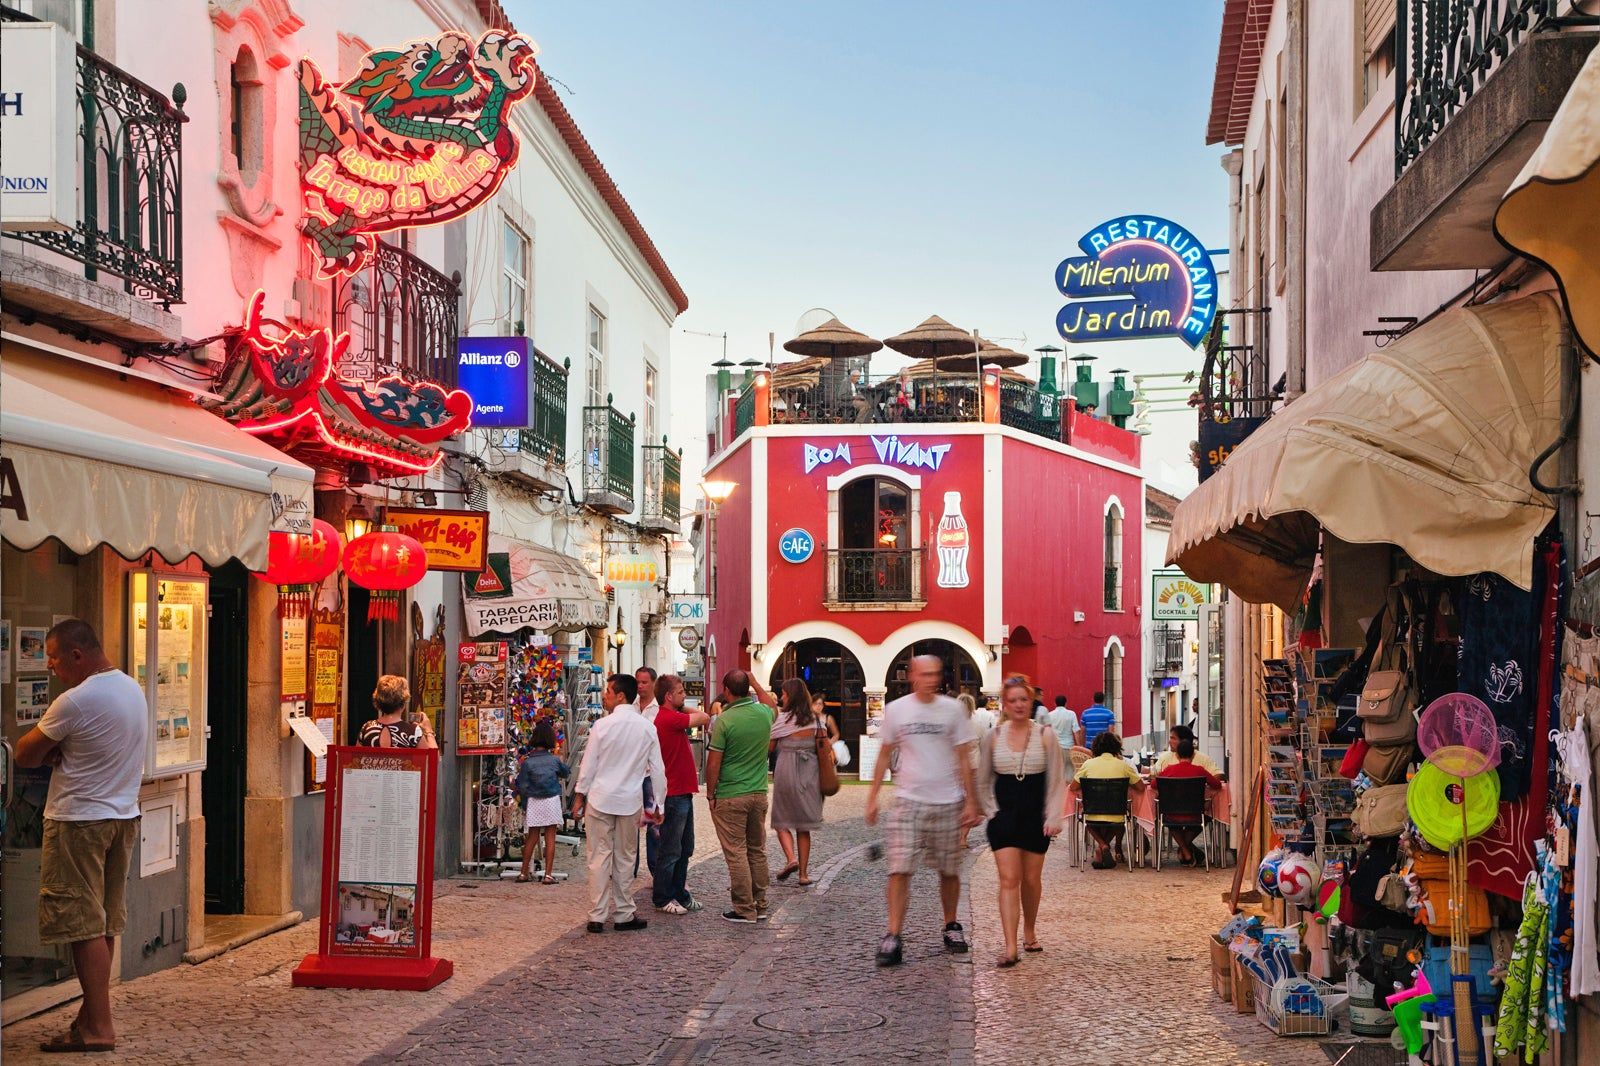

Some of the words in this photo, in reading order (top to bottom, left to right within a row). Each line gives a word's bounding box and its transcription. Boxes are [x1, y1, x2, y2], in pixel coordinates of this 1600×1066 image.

[340, 143, 462, 184] RESTAURANTE
[394, 186, 422, 208] da
[1063, 258, 1170, 288] Milenium
[1090, 219, 1213, 335] RESTAURANTE
[1063, 303, 1171, 333] Jardim
[459, 353, 502, 365] Allianz
[476, 404, 504, 414] Agente
[782, 537, 810, 554] CAFÉ
[480, 578, 497, 587] Delta
[477, 603, 557, 620] TABACARIA
[479, 612, 558, 628] PAPELARIA
